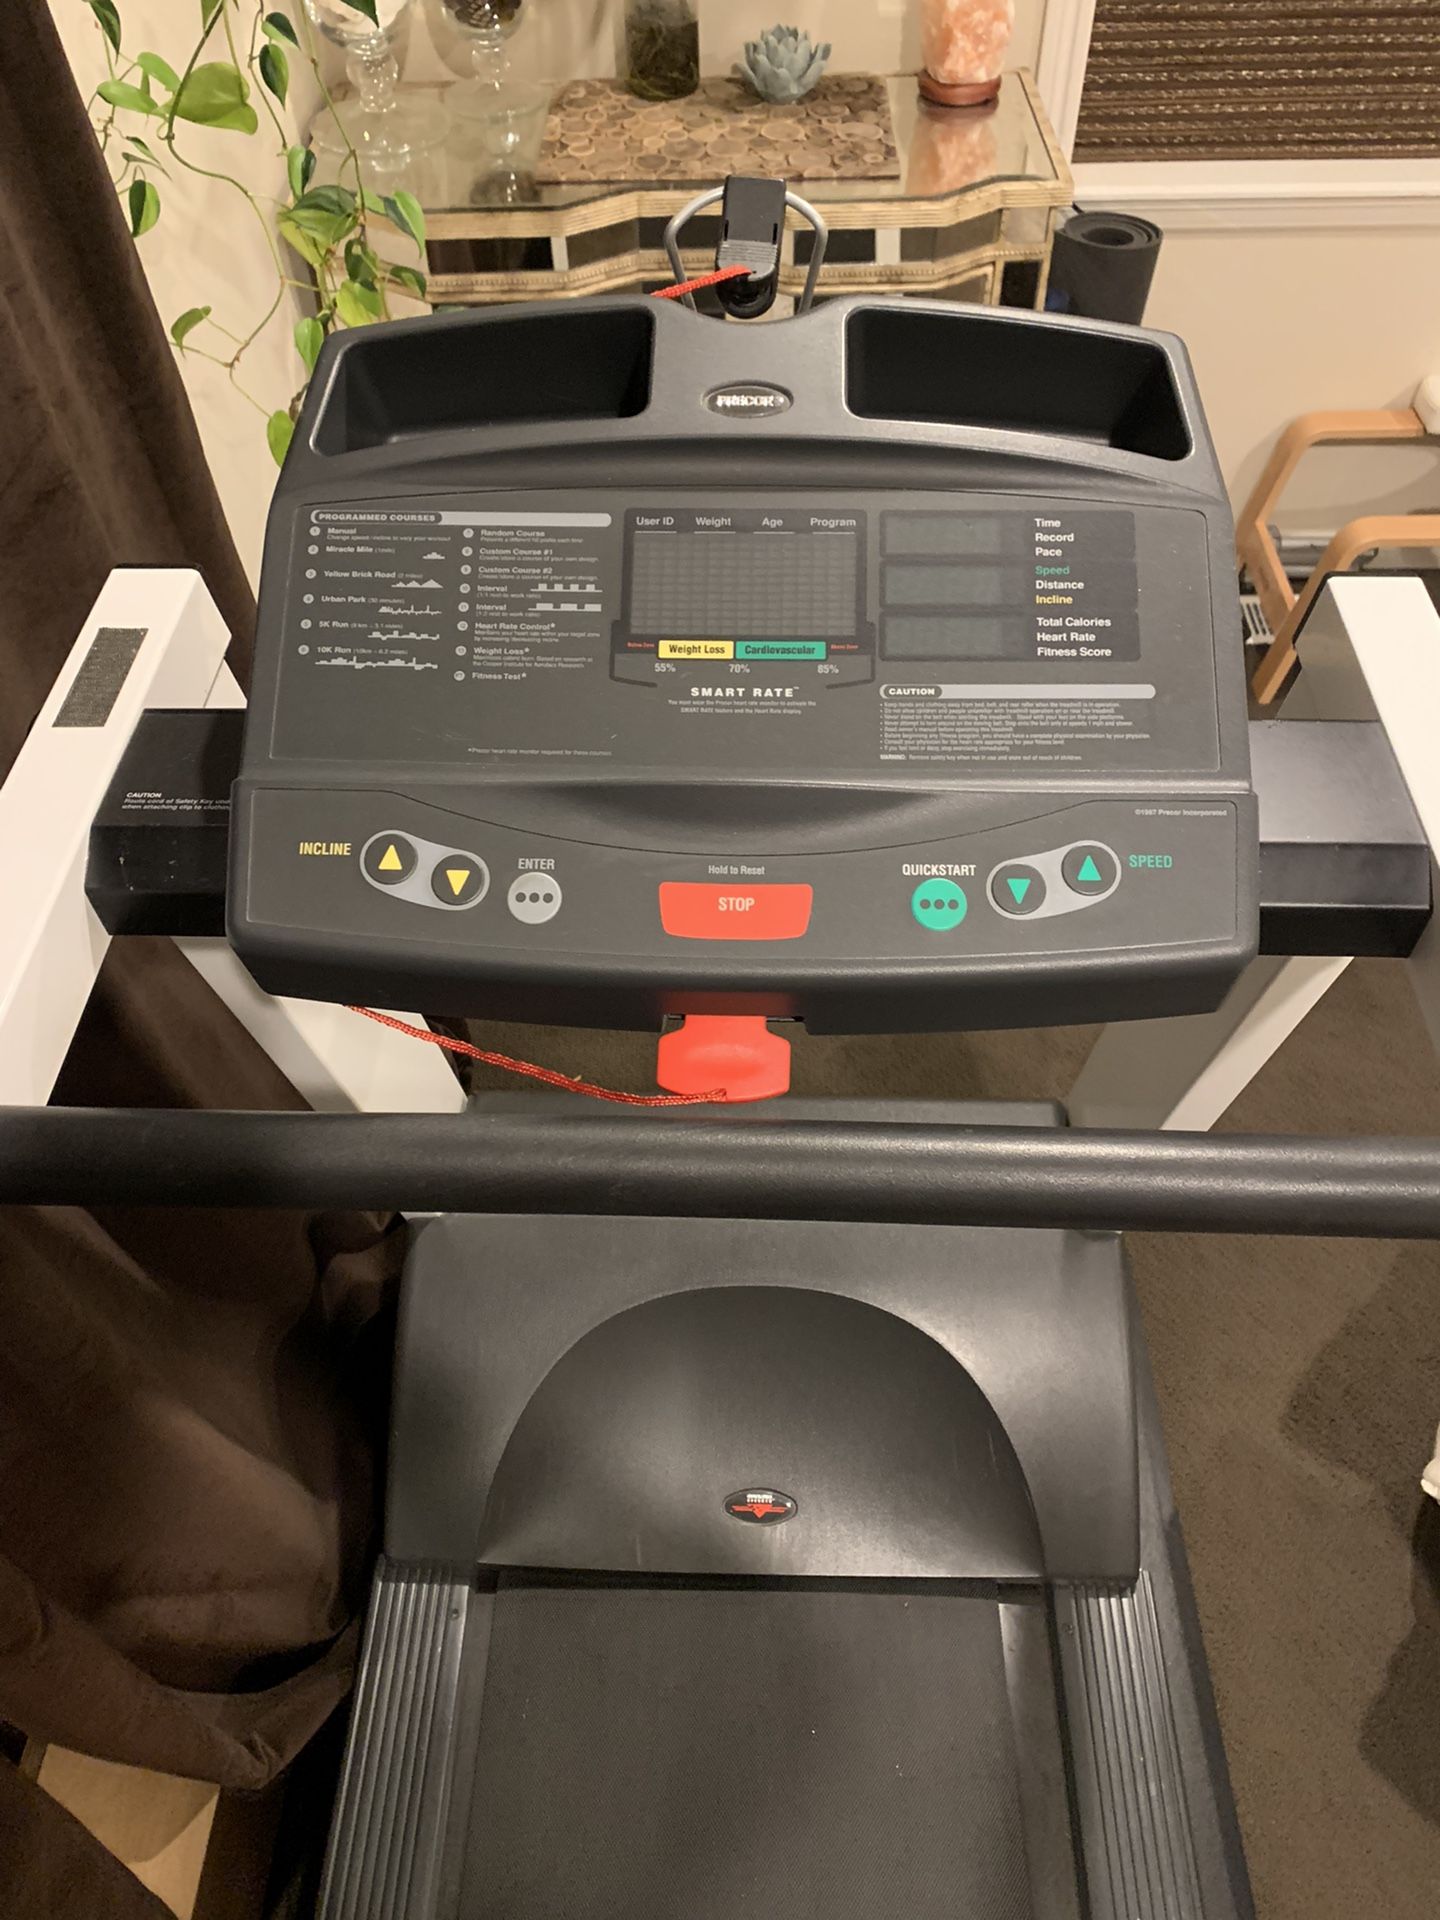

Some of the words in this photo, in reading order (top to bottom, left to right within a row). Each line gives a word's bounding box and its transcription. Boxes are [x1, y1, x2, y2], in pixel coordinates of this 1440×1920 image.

[318, 513, 387, 521] PROGRAMMED
[389, 514, 435, 522] COURSES
[636, 516, 661, 526] User
[663, 517, 674, 526] ID
[695, 516, 731, 527] Weight
[762, 517, 783, 527] Age
[810, 517, 856, 527] Program
[1034, 518, 1061, 528] Time
[1035, 532, 1074, 542] Record
[480, 547, 511, 555] Custom
[1035, 547, 1063, 556] Pace
[1035, 565, 1070, 576] Speed
[1035, 580, 1084, 590] Distance
[321, 595, 346, 603] Urban
[1035, 594, 1073, 604] Incline
[475, 603, 507, 611] Interval
[499, 622, 518, 630] Rate
[1036, 617, 1063, 627] Total
[1065, 617, 1112, 627] Calories
[1037, 632, 1067, 642] Heart
[1070, 632, 1096, 642] Rate
[474, 647, 502, 655] Weight
[669, 644, 702, 655] Weight
[704, 645, 725, 654] Loss
[744, 644, 816, 655] Cardiovascular
[1037, 647, 1077, 657] Fitness
[1079, 647, 1112, 657] Score
[654, 663, 677, 673] 55%
[729, 664, 750, 674] 70%
[817, 664, 839, 674] 85%
[472, 672, 503, 680] Fitness
[690, 687, 746, 697] SMART
[888, 687, 935, 696] CAUTION
[299, 842, 351, 856] INCLINE
[517, 858, 555, 870] ENTER
[1129, 855, 1172, 869] SPEED
[708, 865, 728, 874] Hold
[730, 865, 739, 875] to
[740, 865, 765, 875] Reset
[902, 863, 976, 877] QUICKSTART
[718, 896, 755, 912] STOP
